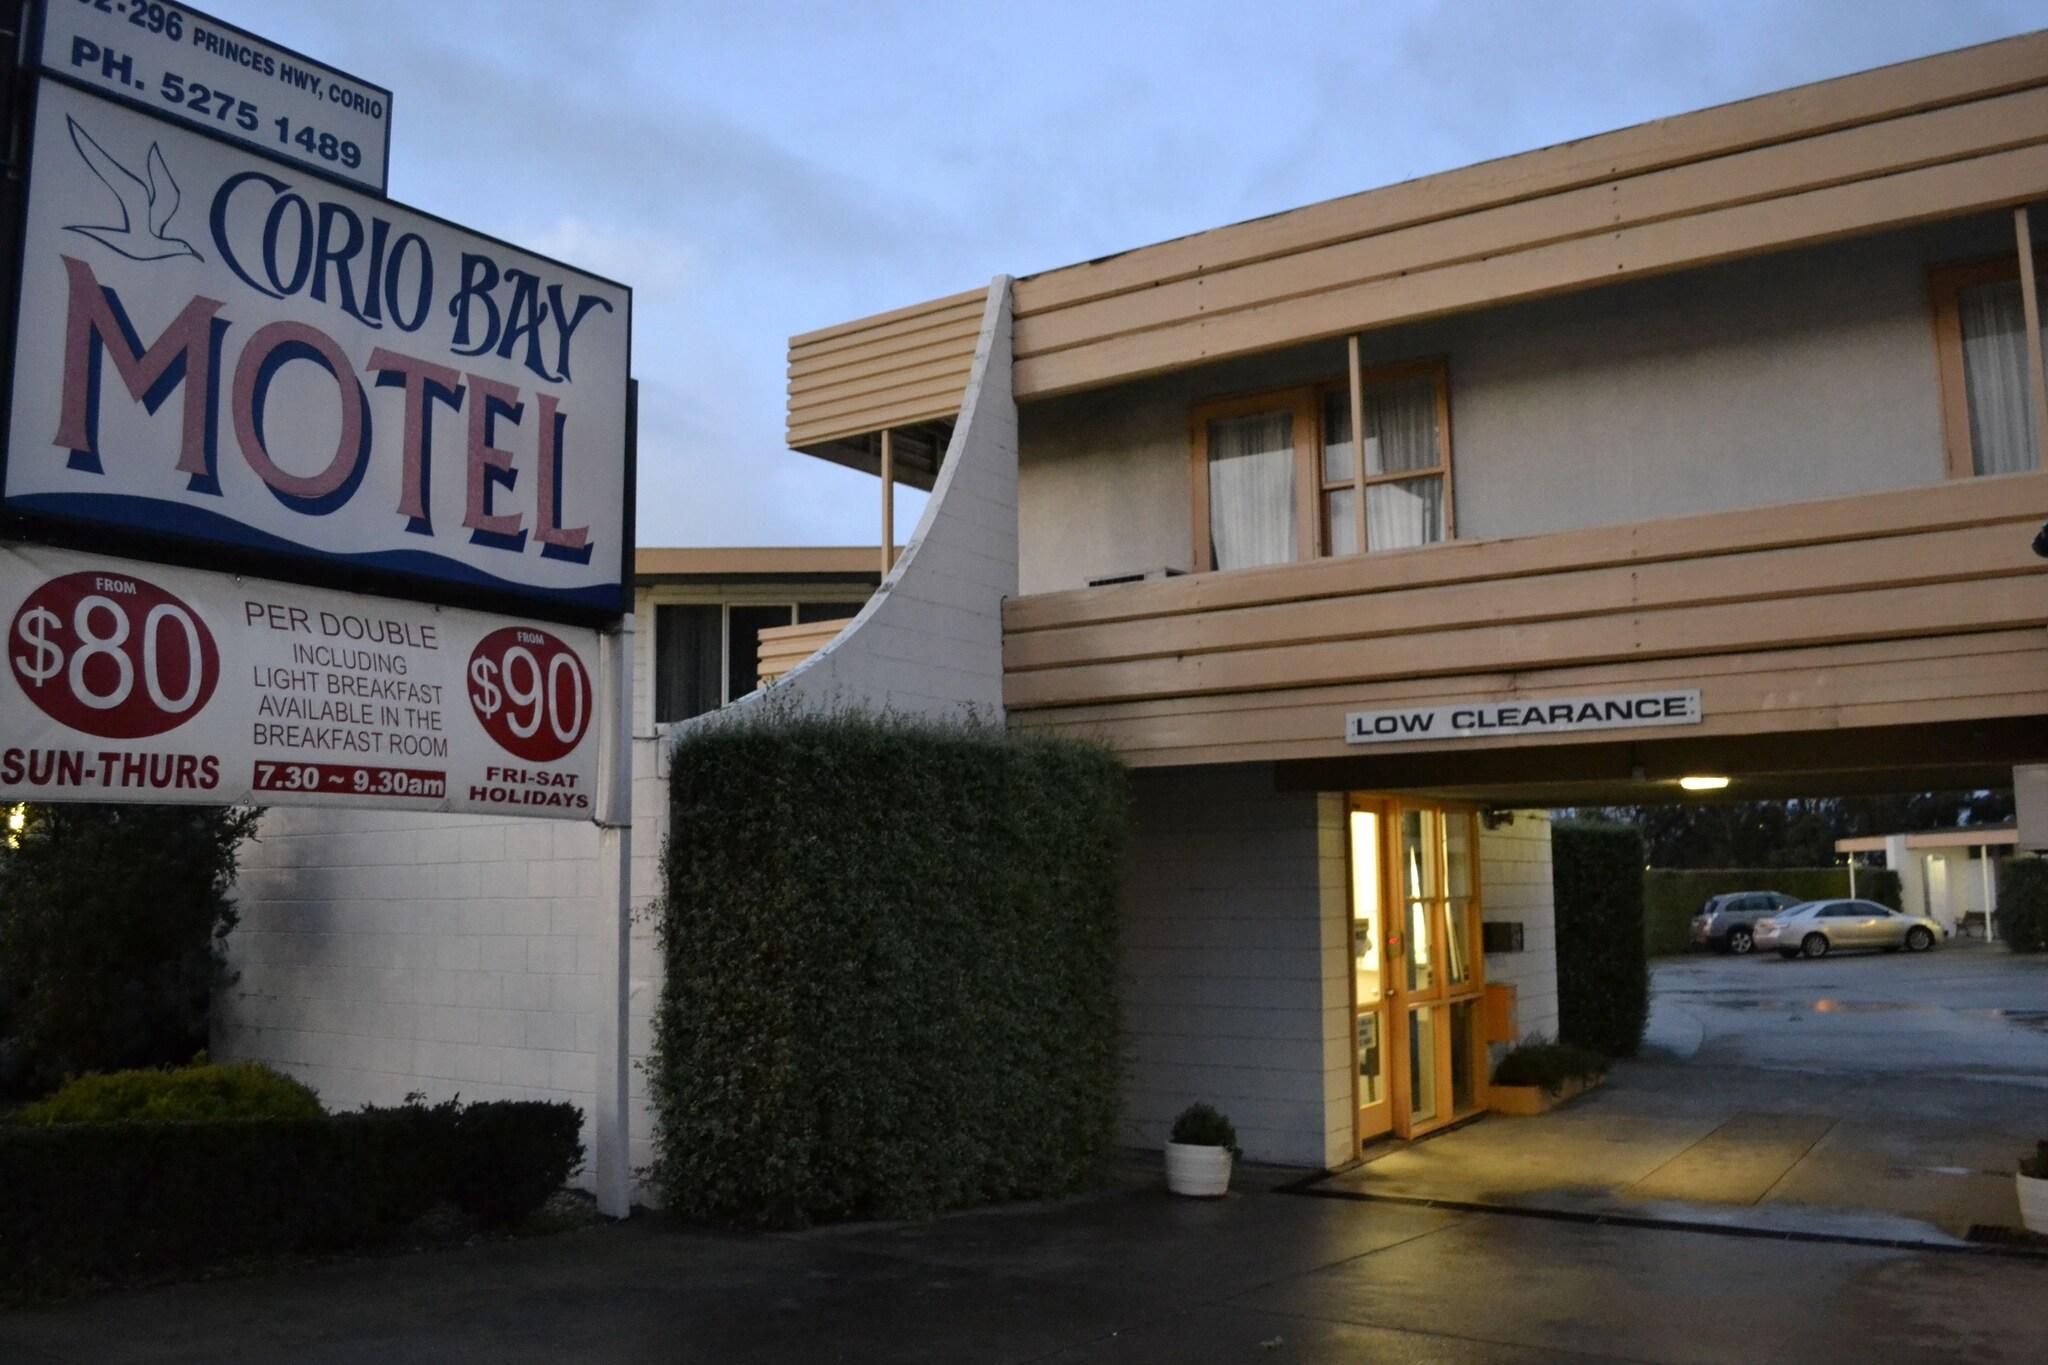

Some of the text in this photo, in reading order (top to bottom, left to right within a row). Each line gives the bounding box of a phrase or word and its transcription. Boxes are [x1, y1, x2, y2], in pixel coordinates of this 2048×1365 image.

[81, 0, 383, 120] -296 PRINCES HWY, CORIO
[71, 35, 361, 169] PH. 5275 1489
[209, 171, 614, 384] CORIO BAY
[53, 254, 595, 566] MOTEL
[96, 577, 137, 595] FROM
[245, 601, 439, 650] PER DOUBLE
[517, 632, 545, 645] FROM
[16, 595, 203, 713] $80
[293, 643, 408, 676] INCLUDING
[254, 666, 443, 705] LIGHT BREAKFAST
[471, 646, 583, 743] $90
[258, 695, 443, 731] AVAILABLE IN THE
[1356, 697, 1688, 736] LOW CLEARANCE
[254, 723, 448, 758] BREAKFAST ROOM
[1, 748, 221, 790] SUN-THURS
[257, 764, 320, 790] 7.30
[353, 769, 445, 796] 9.30am
[486, 766, 579, 788] FRI-SAT
[469, 786, 589, 809] HOLIDAYS
